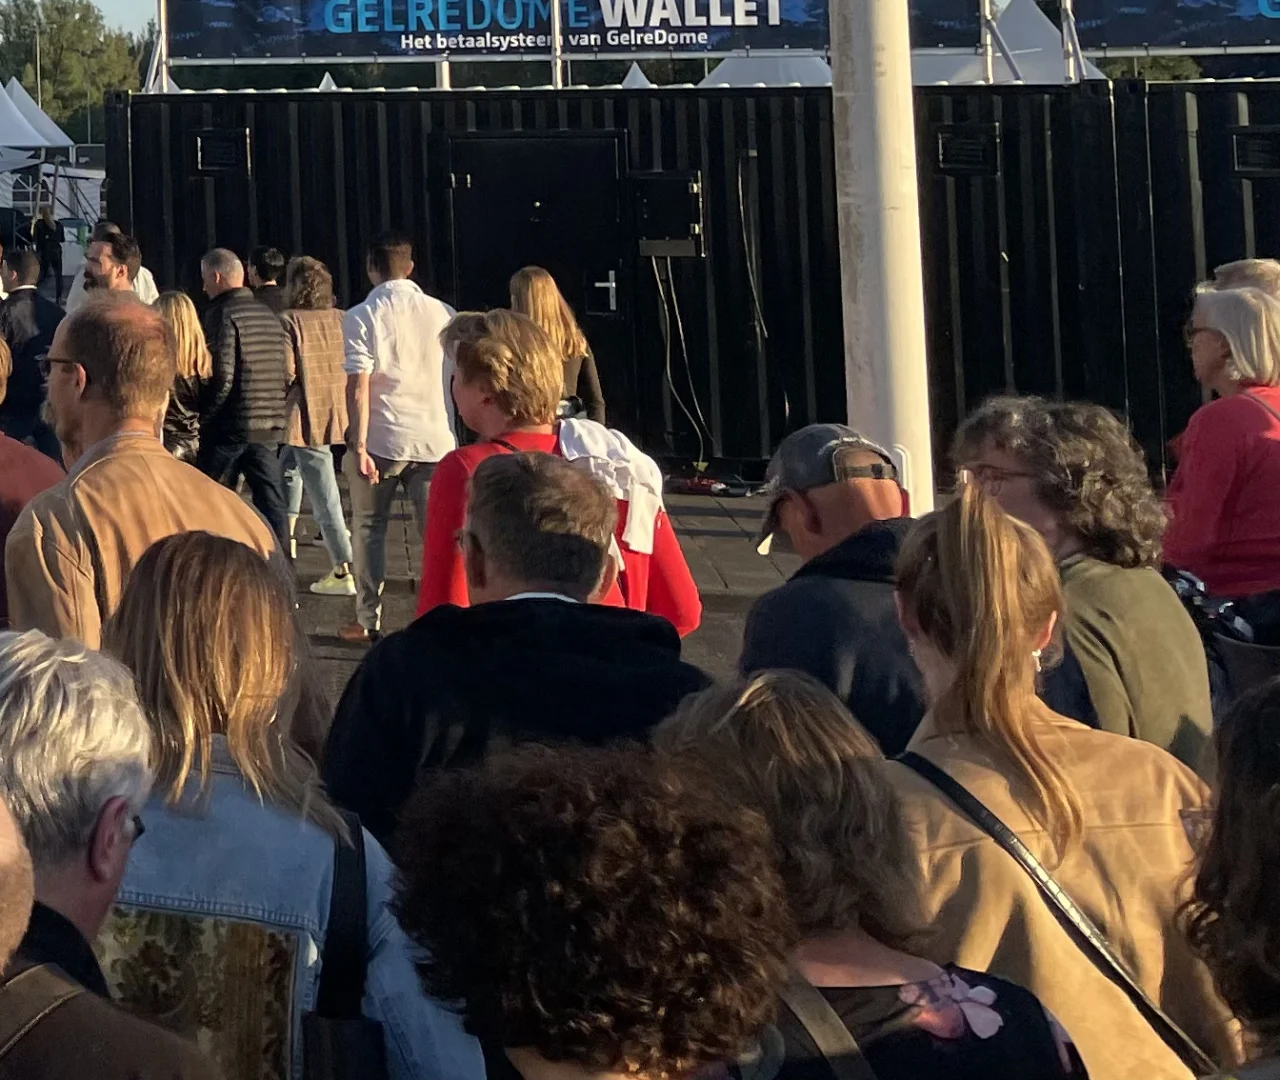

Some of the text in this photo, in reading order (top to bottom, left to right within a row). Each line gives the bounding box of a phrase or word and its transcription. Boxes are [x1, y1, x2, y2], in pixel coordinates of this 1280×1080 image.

[400, 33, 432, 50] Het
[569, 33, 601, 46] van
[606, 28, 709, 46] GelreDome
